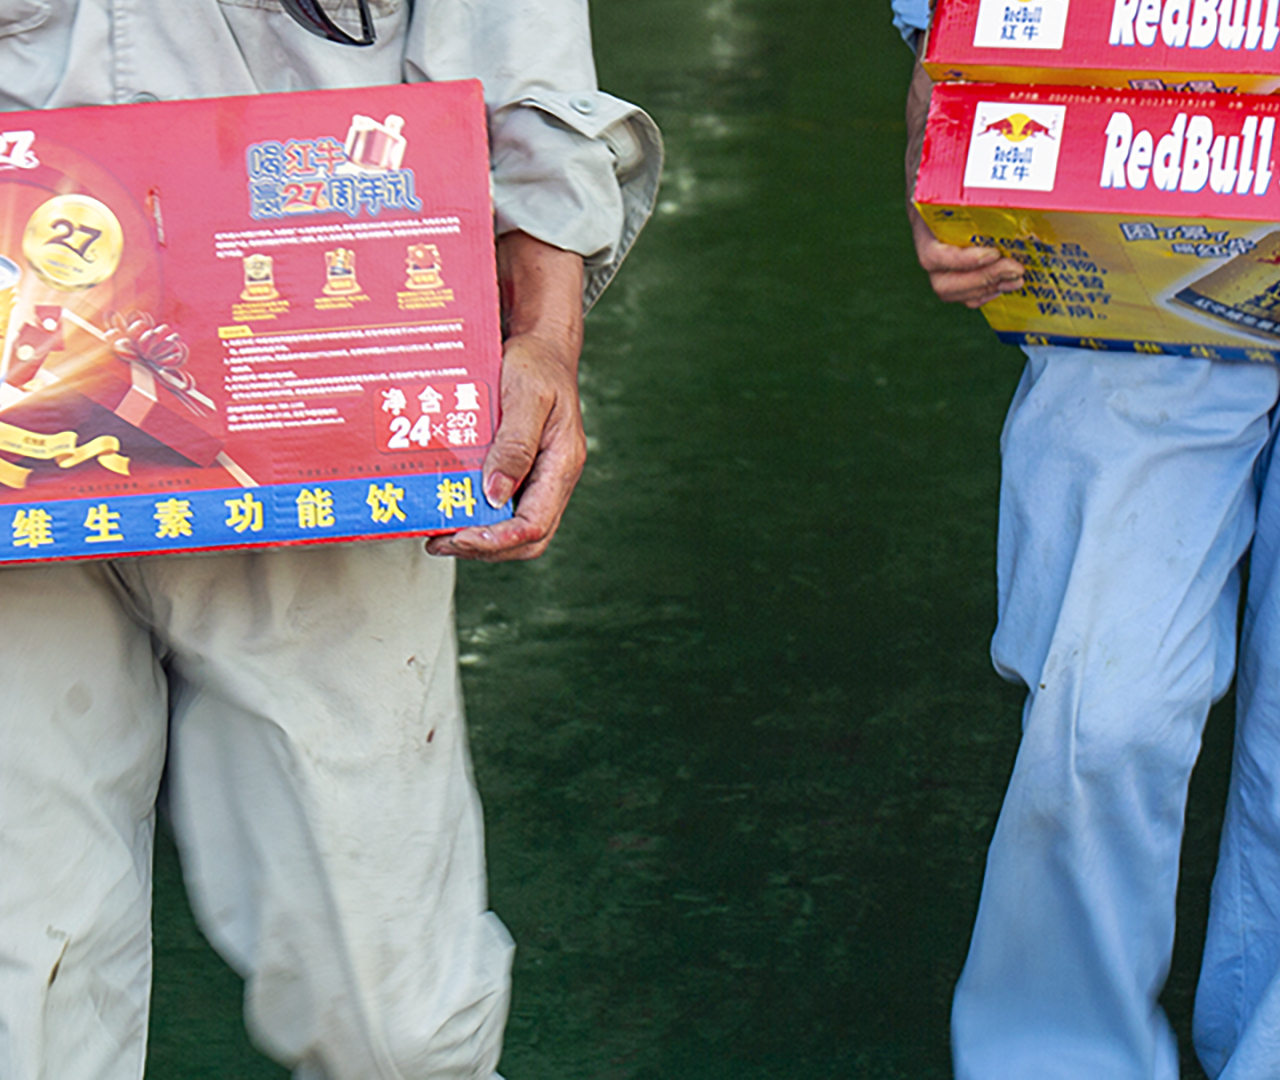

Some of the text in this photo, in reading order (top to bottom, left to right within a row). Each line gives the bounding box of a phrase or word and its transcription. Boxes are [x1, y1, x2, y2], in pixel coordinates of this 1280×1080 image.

[1001, 25, 1039, 41] 红牛
[1100, 112, 1276, 196] RedBull
[991, 165, 1029, 181] 红牛
[43, 218, 103, 263] 27
[381, 383, 480, 415] 净含量
[446, 412, 477, 428] 250
[447, 428, 478, 445] 毫升
